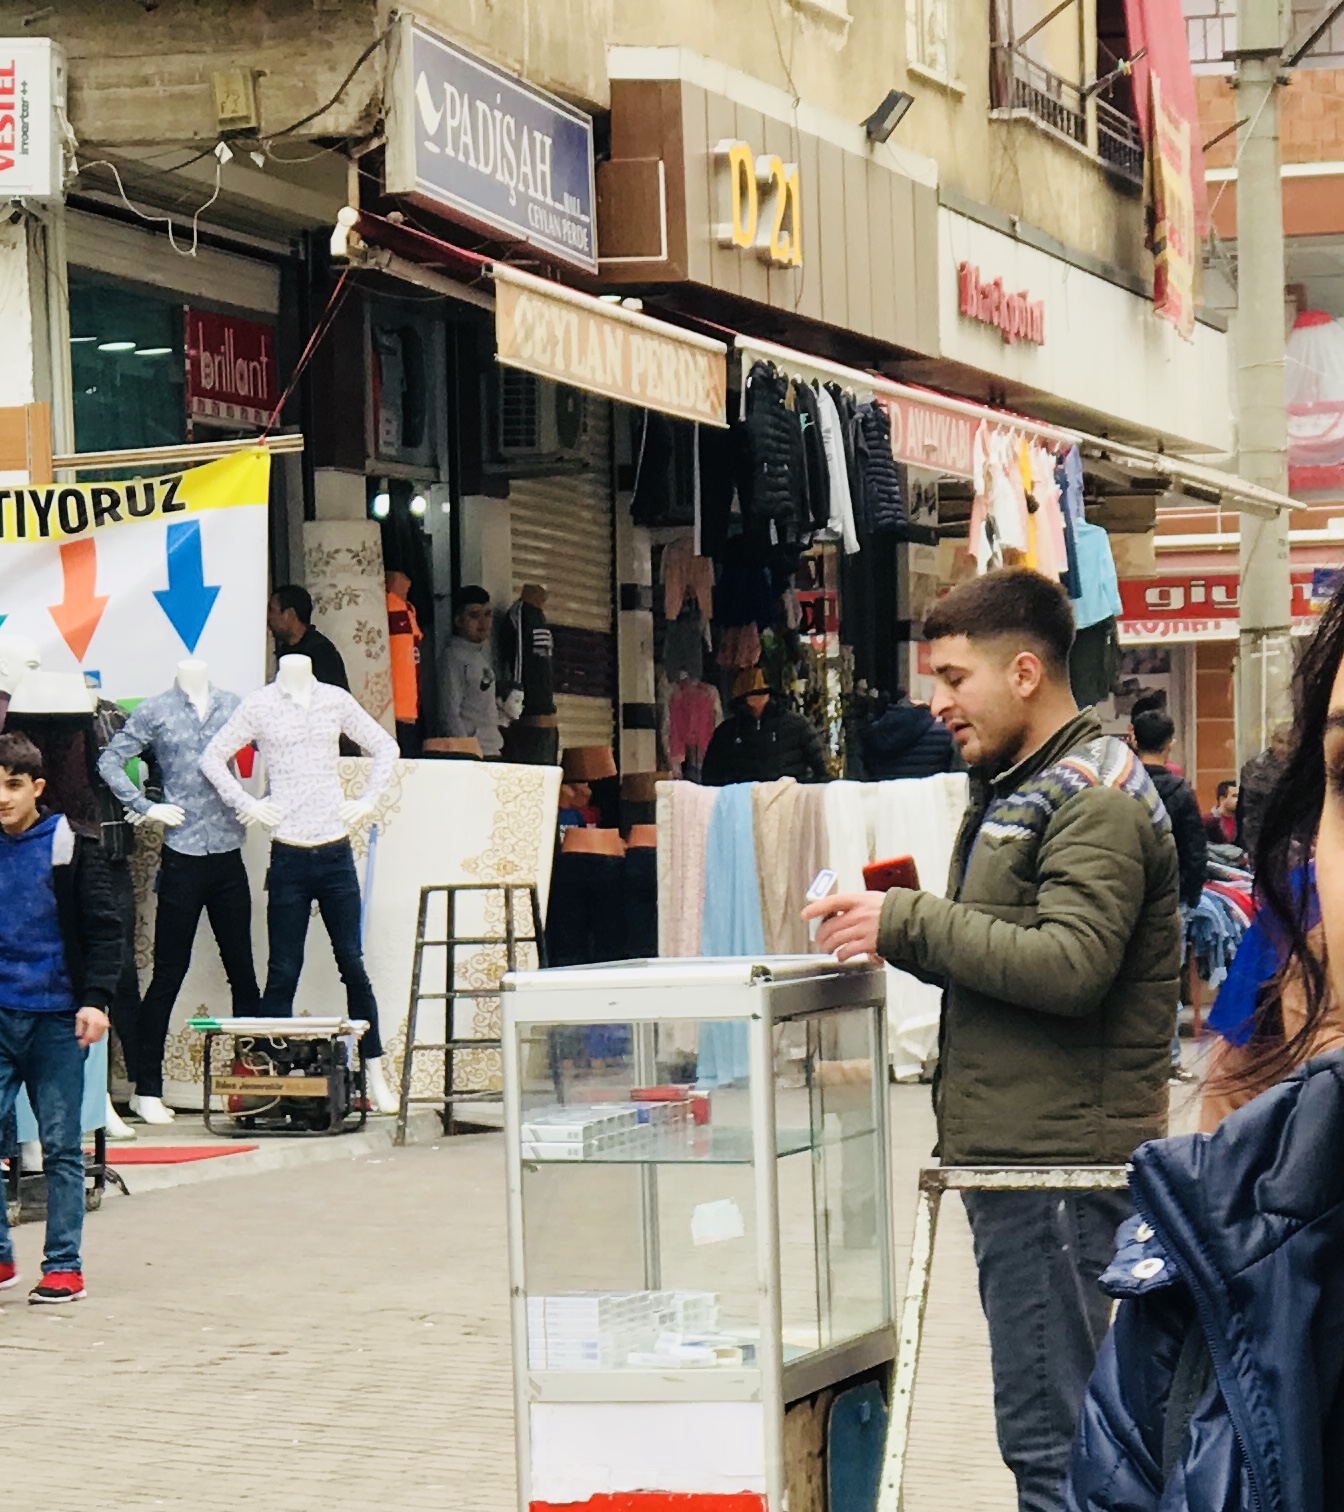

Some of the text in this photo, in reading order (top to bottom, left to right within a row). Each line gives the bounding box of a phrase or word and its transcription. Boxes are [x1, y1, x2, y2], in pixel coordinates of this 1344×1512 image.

[443, 82, 553, 207] PADİŞAH
[198, 321, 269, 400] brillant
[513, 294, 712, 413] CEYLAN PERDE
